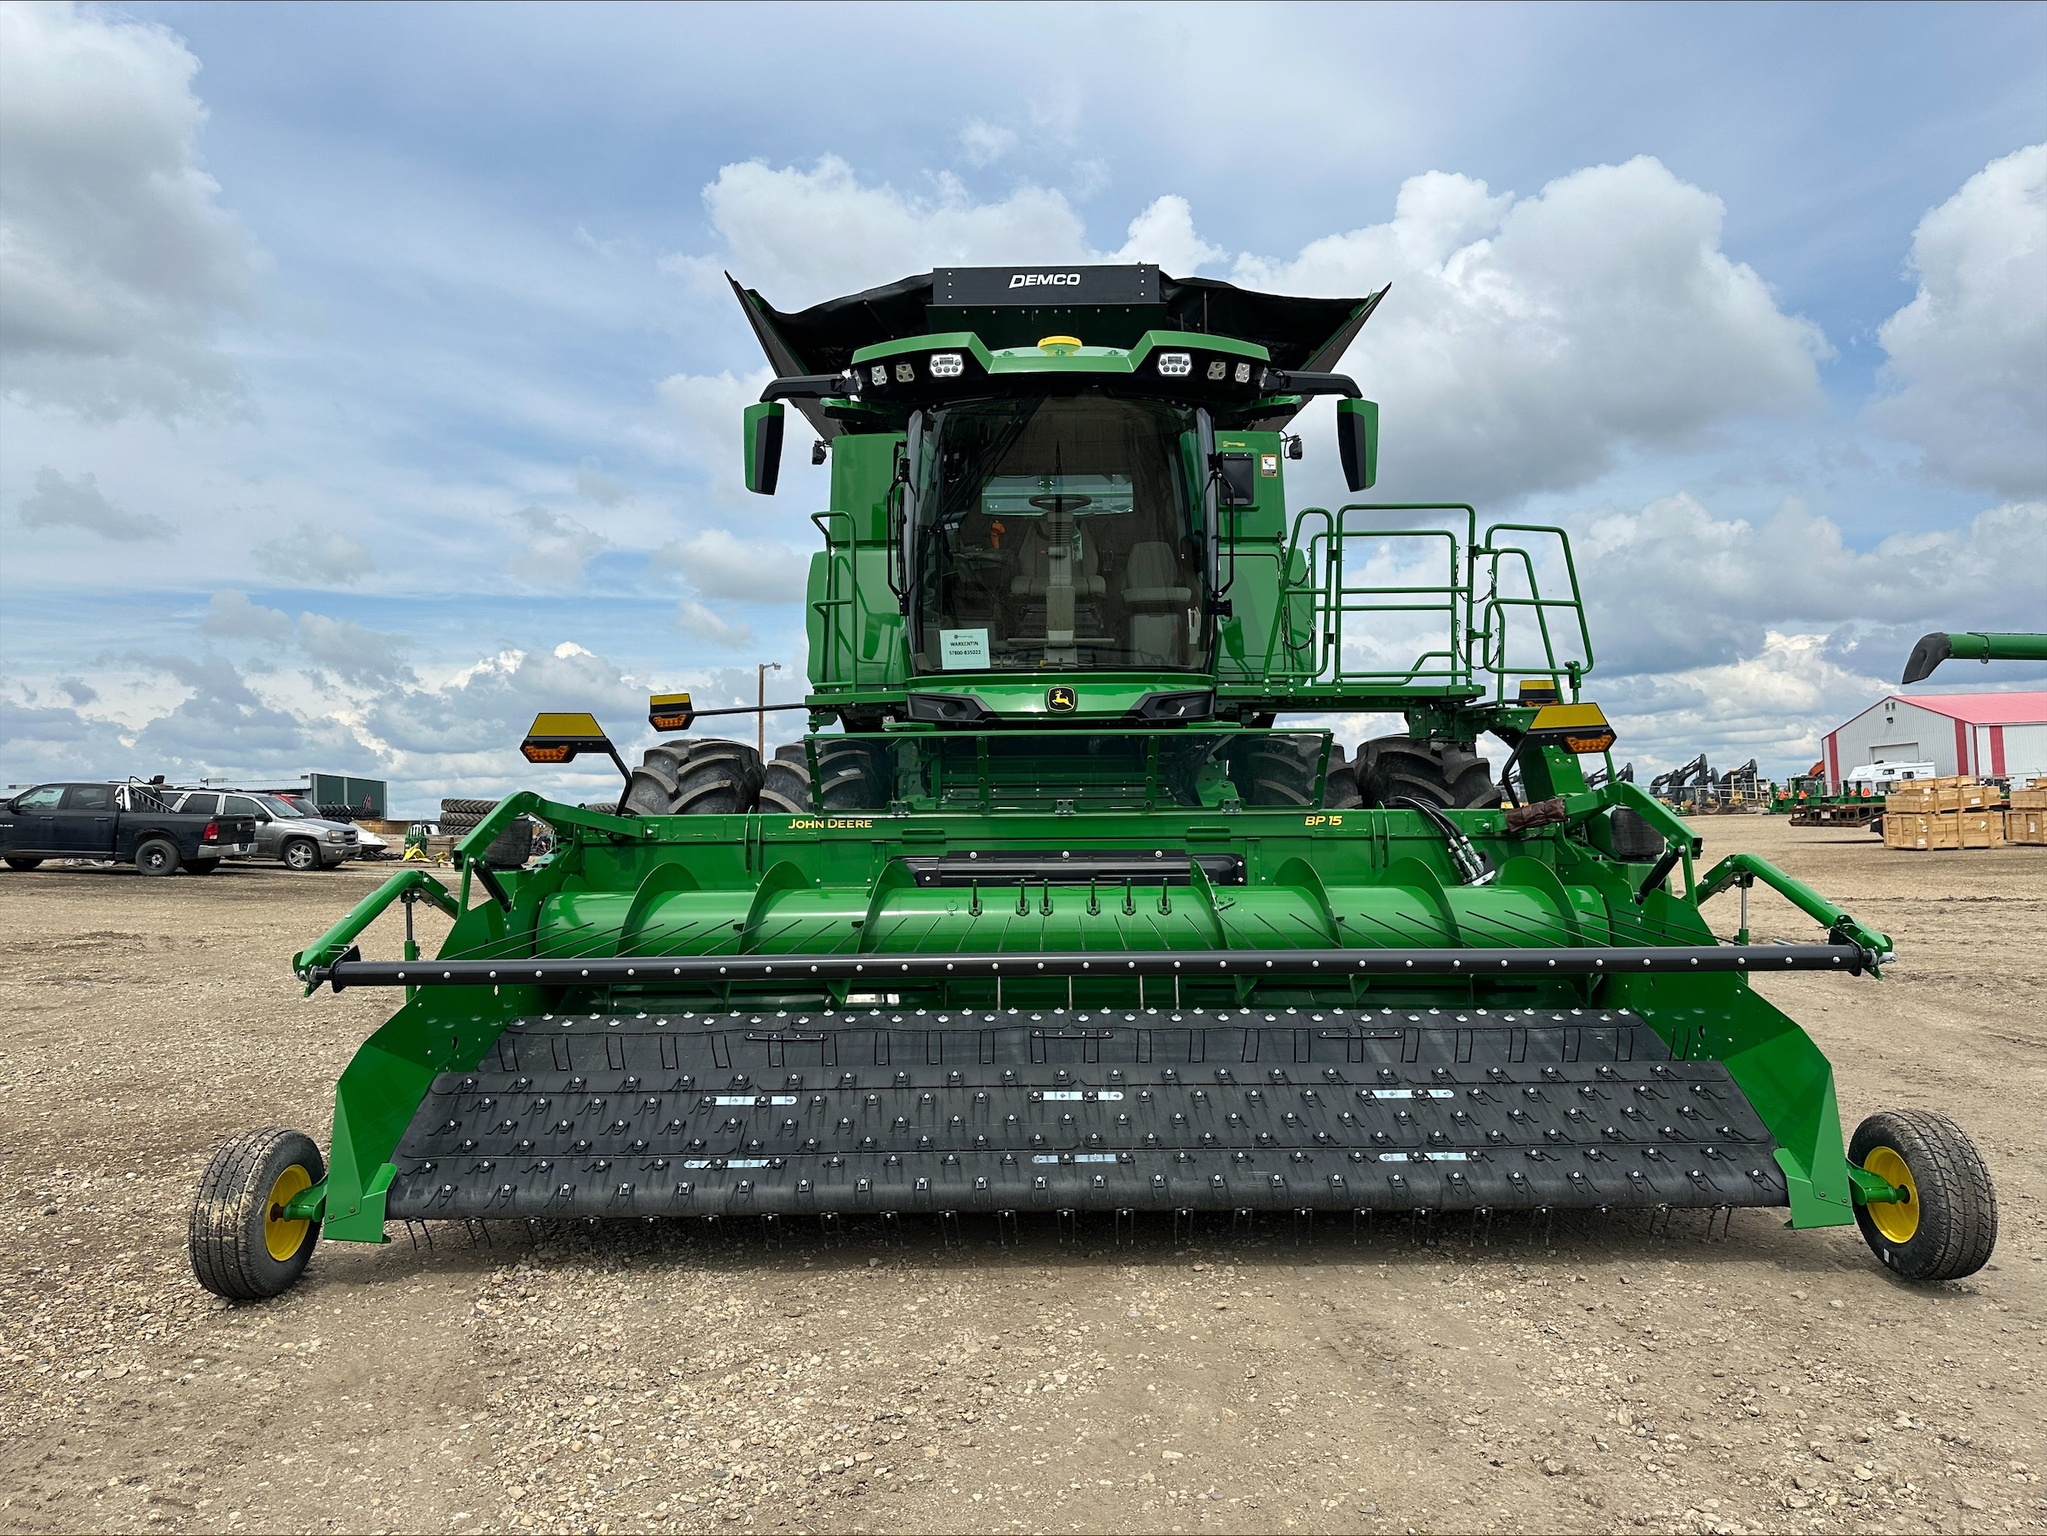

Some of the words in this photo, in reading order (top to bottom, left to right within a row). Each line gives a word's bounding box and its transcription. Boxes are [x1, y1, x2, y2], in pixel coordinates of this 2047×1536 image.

[1008, 273, 1081, 289] DEMCO
[1304, 815, 1326, 826] BP
[1328, 815, 1343, 826] 15
